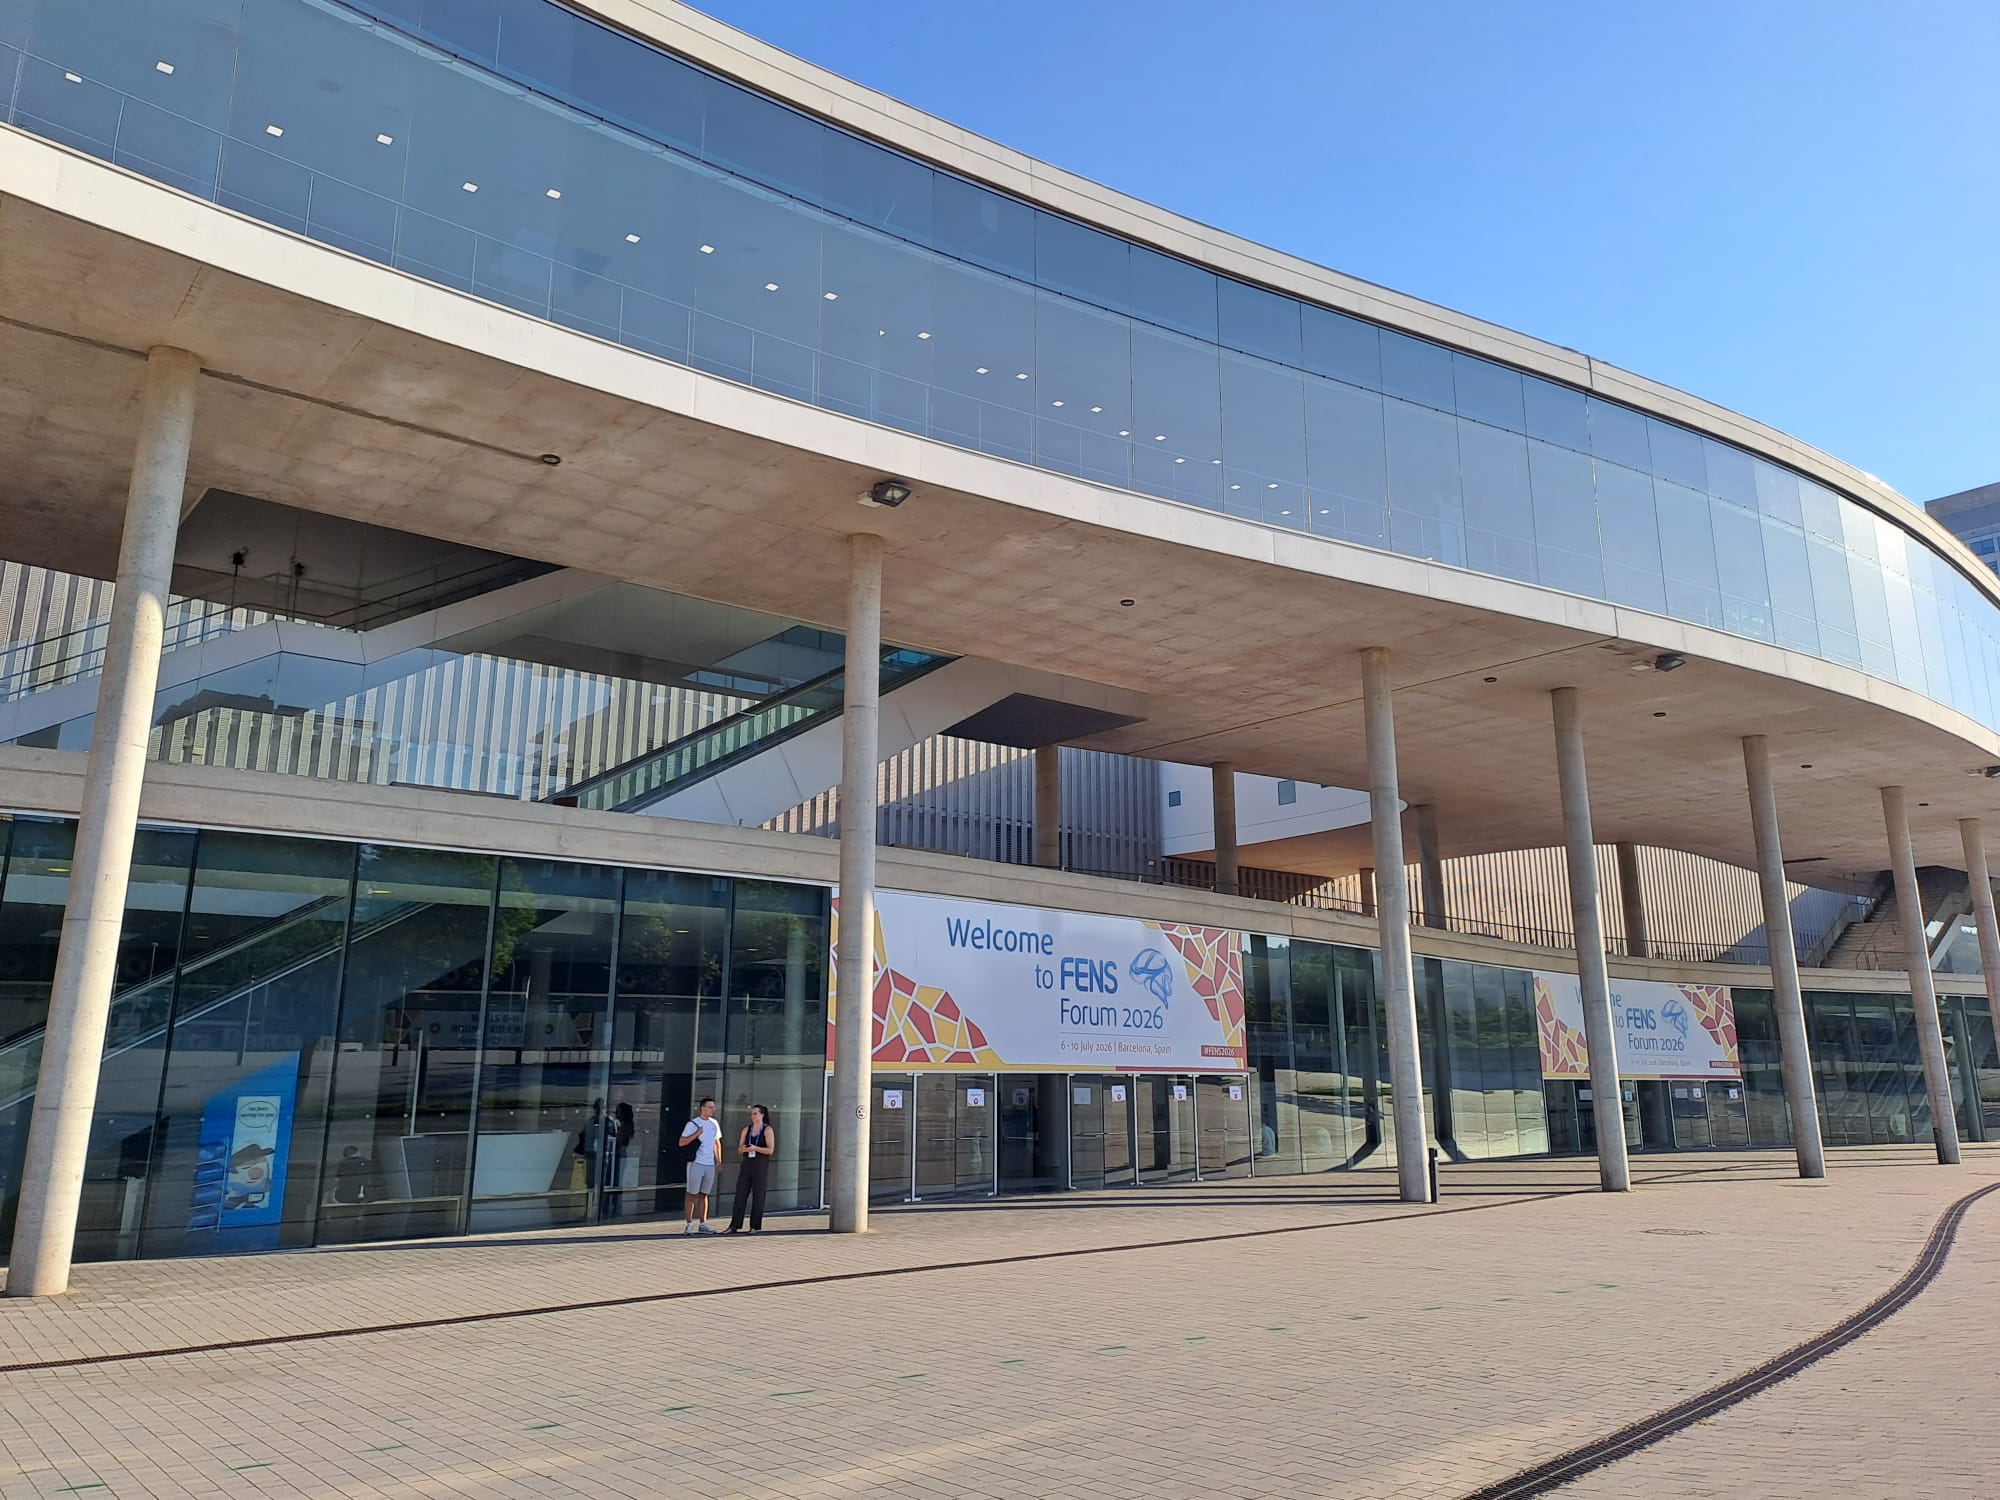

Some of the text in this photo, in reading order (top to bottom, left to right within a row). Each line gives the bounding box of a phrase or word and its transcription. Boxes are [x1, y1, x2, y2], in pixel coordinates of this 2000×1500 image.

[946, 917, 1054, 955] Welcome
[1035, 957, 1118, 994] to FENS
[1060, 998, 1164, 1030] Forum 2026
[1615, 1007, 1657, 1031] to FENS
[1080, 1041, 1094, 1053] July
[1096, 1042, 1113, 1053] 2026
[1117, 1042, 1153, 1055] Barcelona,
[1154, 1044, 1172, 1055] Spain
[1204, 1047, 1236, 1057] #FENS2026
[1628, 1033, 1685, 1051] Forum 2026
